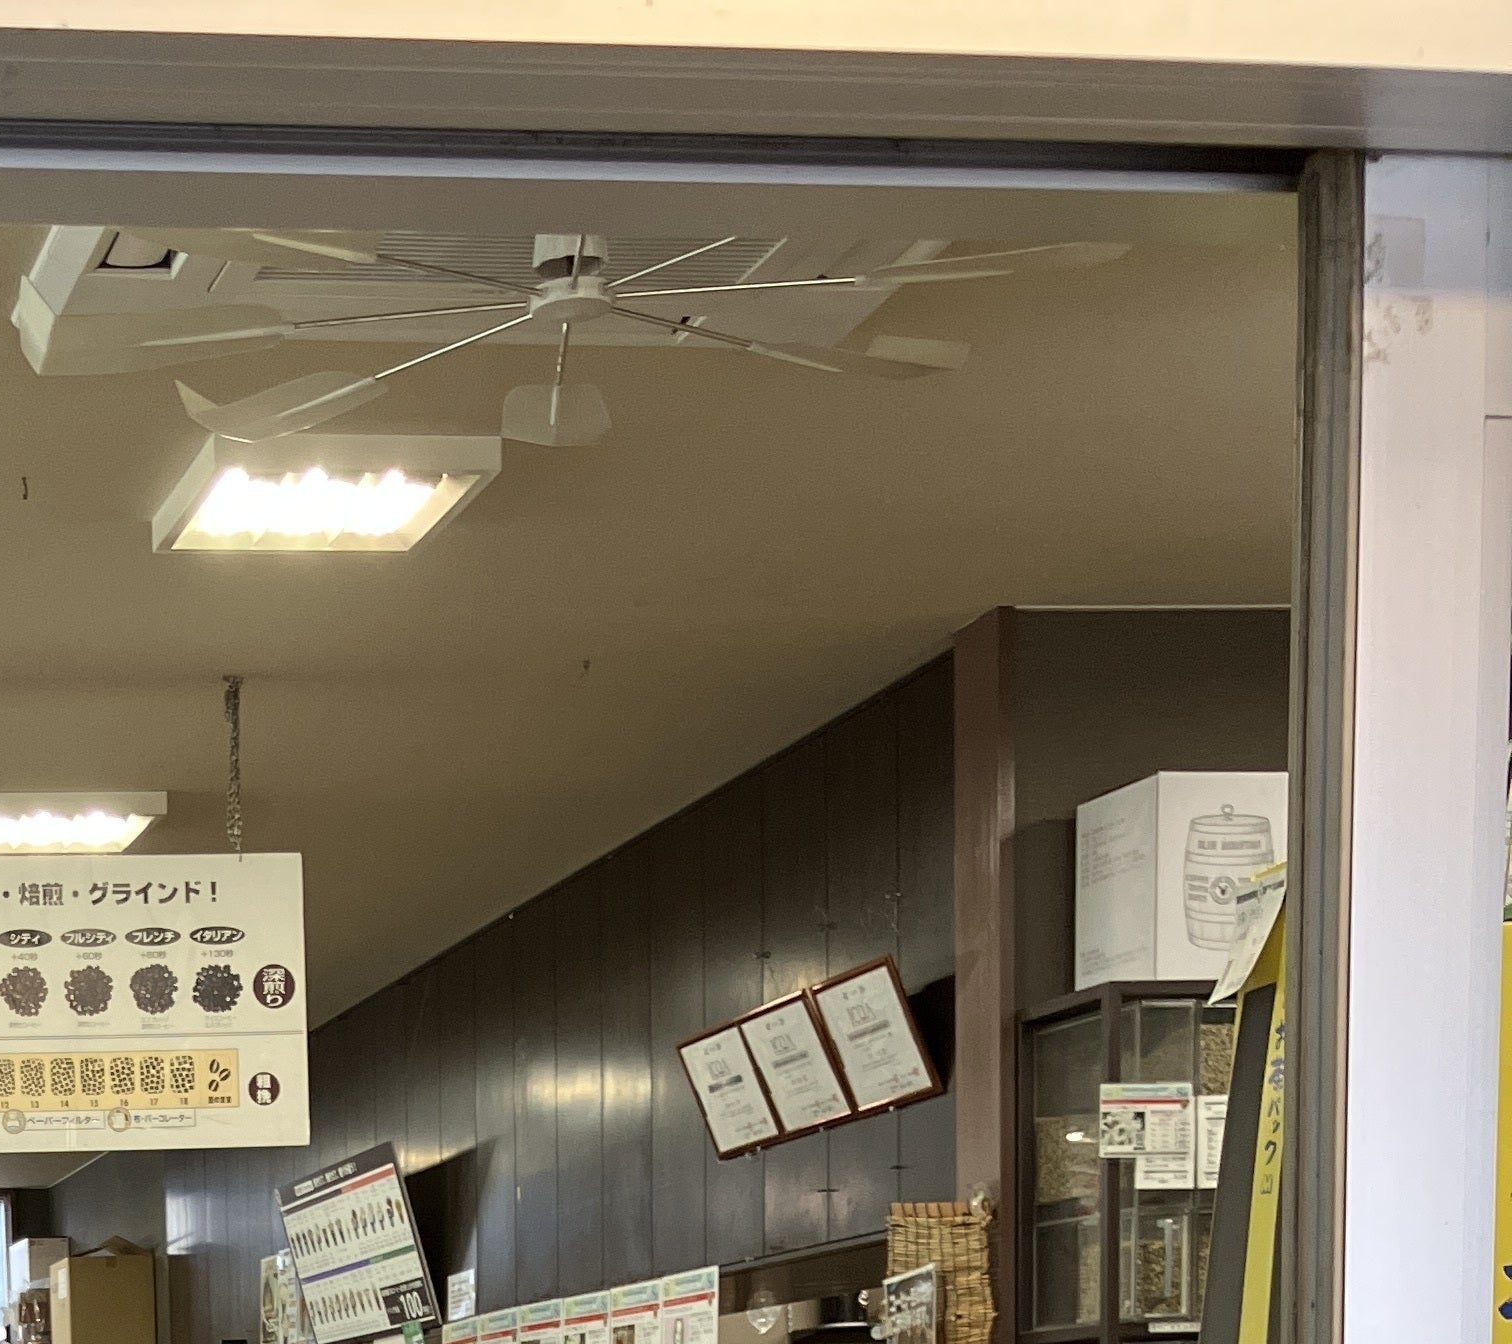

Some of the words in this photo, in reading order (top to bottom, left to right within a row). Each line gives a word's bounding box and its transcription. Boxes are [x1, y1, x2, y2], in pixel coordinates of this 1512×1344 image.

[9, 931, 41, 945] シティ
[63, 931, 115, 944] フルシティ
[131, 930, 174, 943] フレンチ
[192, 929, 243, 942] イタリアン
[262, 968, 286, 1007] 深煎り
